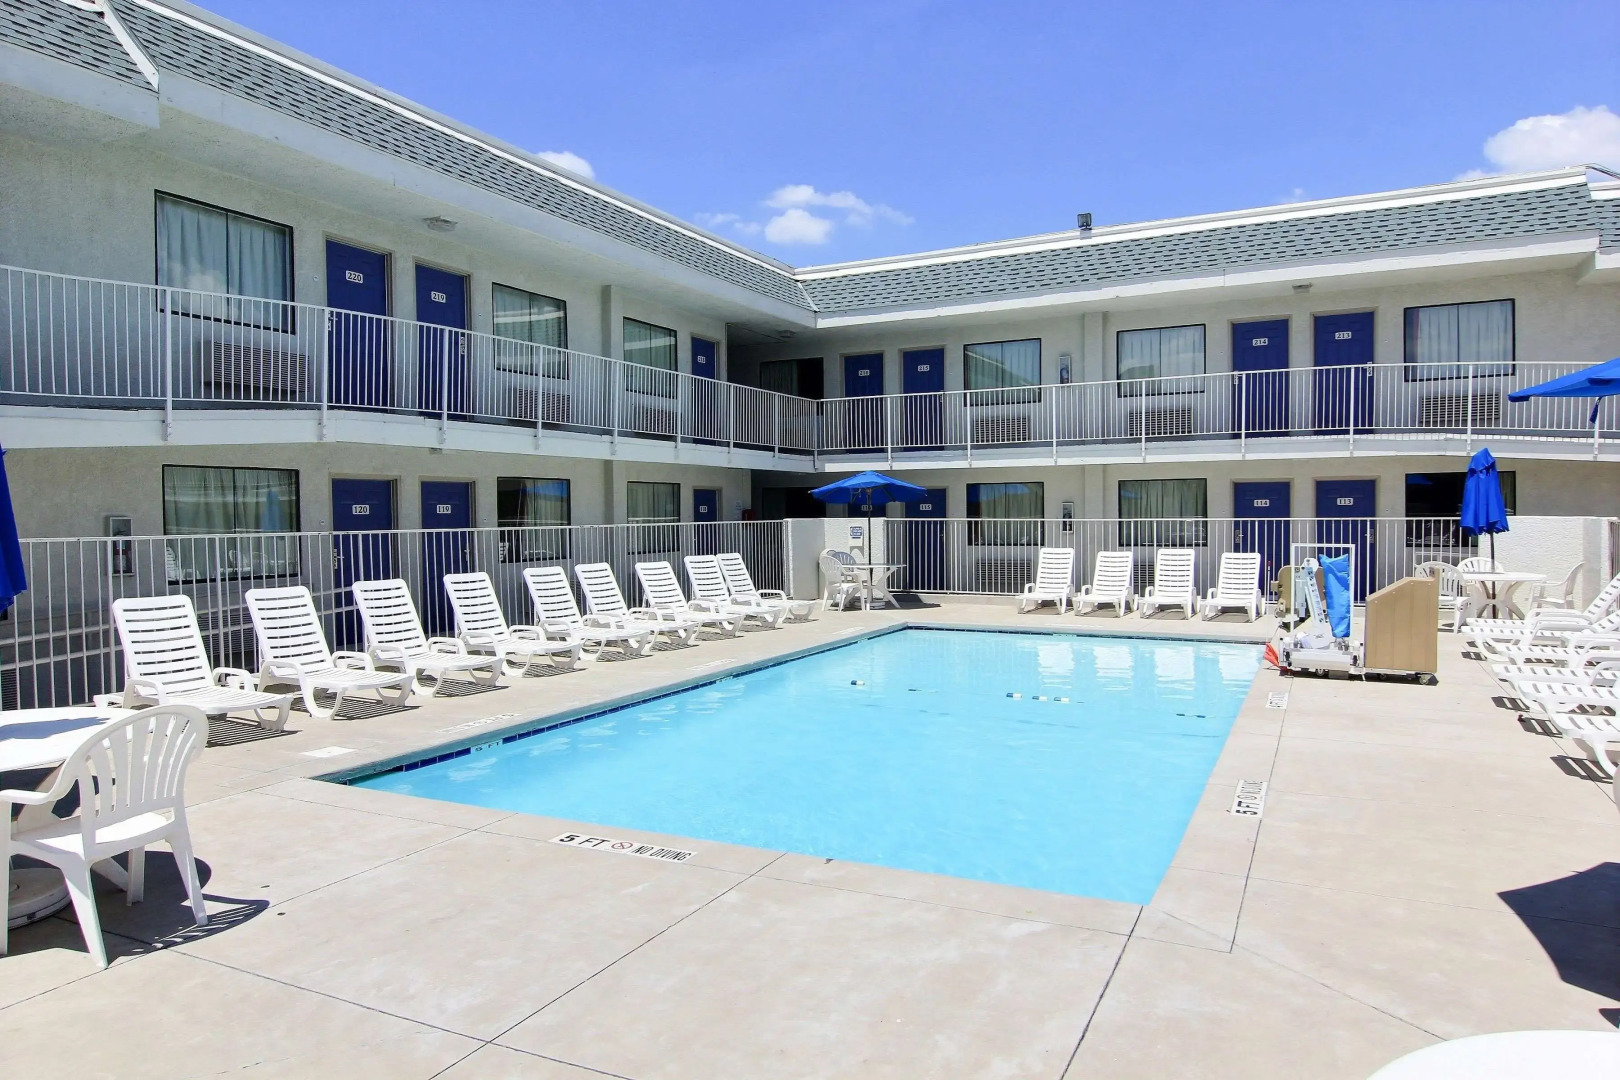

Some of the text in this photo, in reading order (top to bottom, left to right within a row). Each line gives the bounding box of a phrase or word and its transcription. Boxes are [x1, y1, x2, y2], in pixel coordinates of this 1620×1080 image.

[347, 272, 362, 282] 220
[432, 293, 445, 302] 219
[1254, 338, 1267, 346] 214
[354, 505, 368, 514] 120
[438, 505, 450, 513] 119
[559, 834, 692, 861] 5 FT NO DIVING
